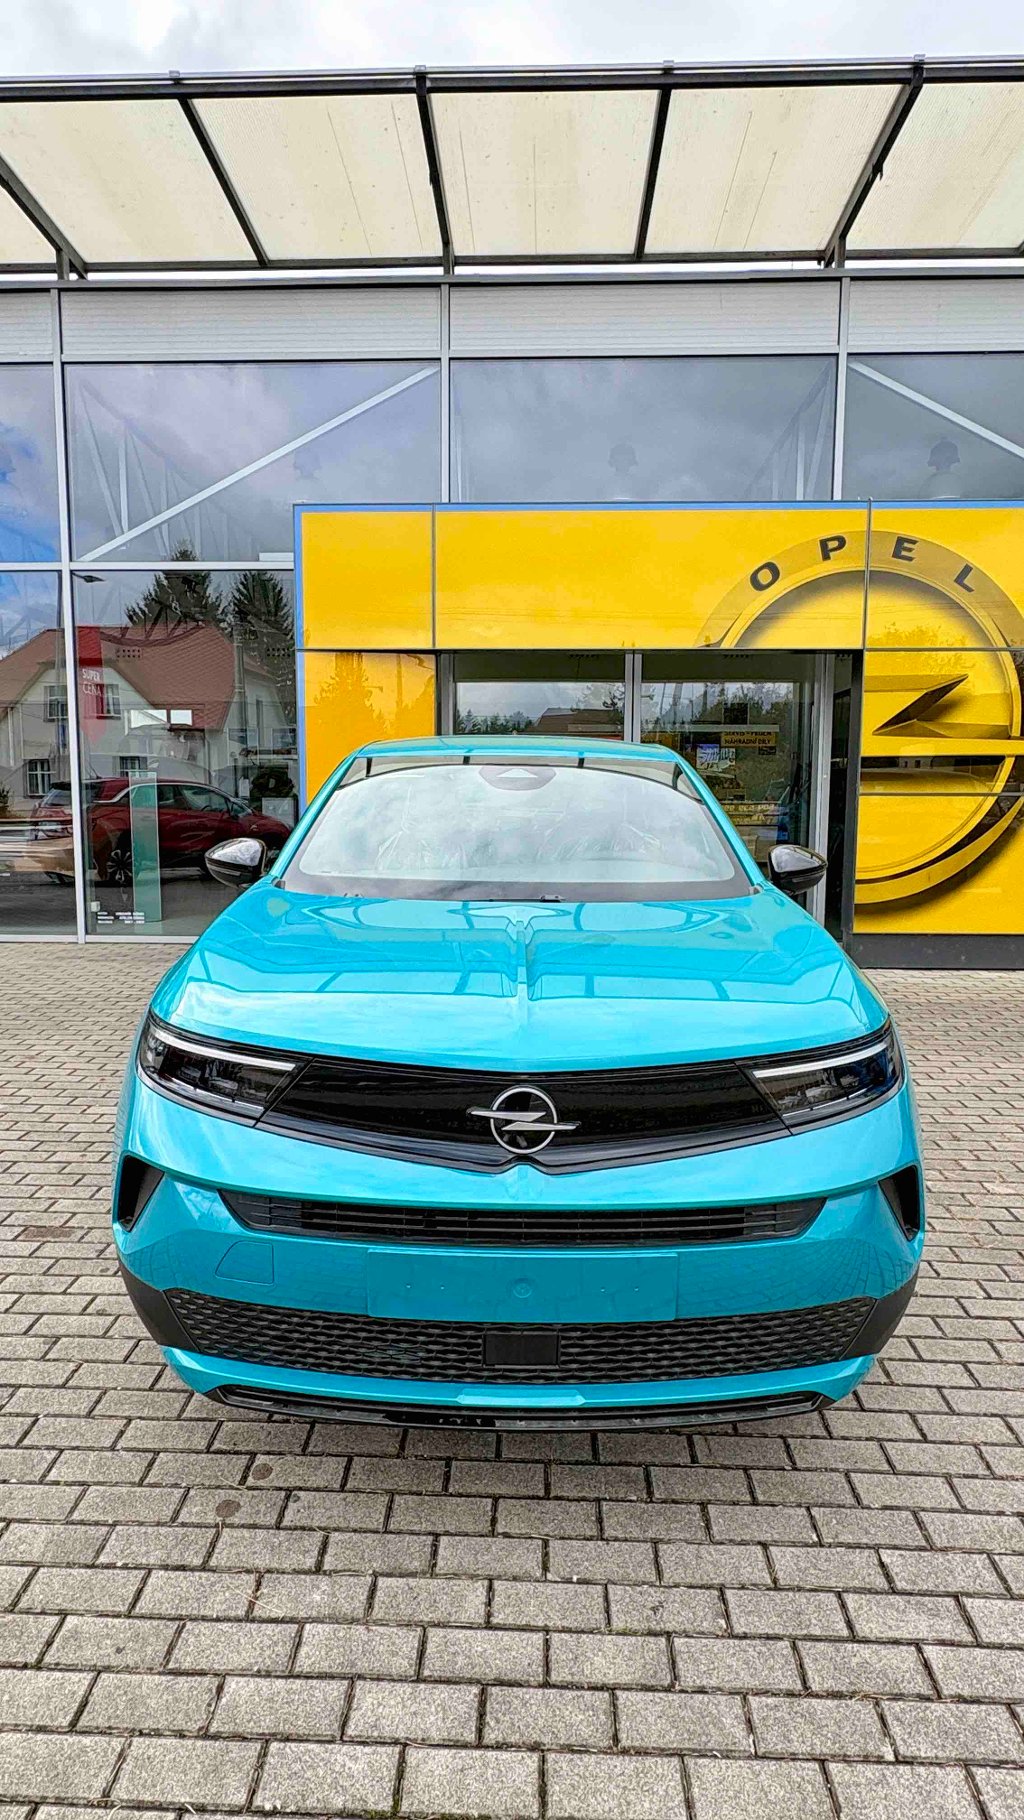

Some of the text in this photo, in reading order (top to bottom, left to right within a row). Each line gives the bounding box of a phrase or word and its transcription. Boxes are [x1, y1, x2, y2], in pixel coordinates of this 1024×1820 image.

[750, 535, 975, 593] OPEL
[82, 668, 100, 682] SUPER
[82, 681, 102, 696] CENA
